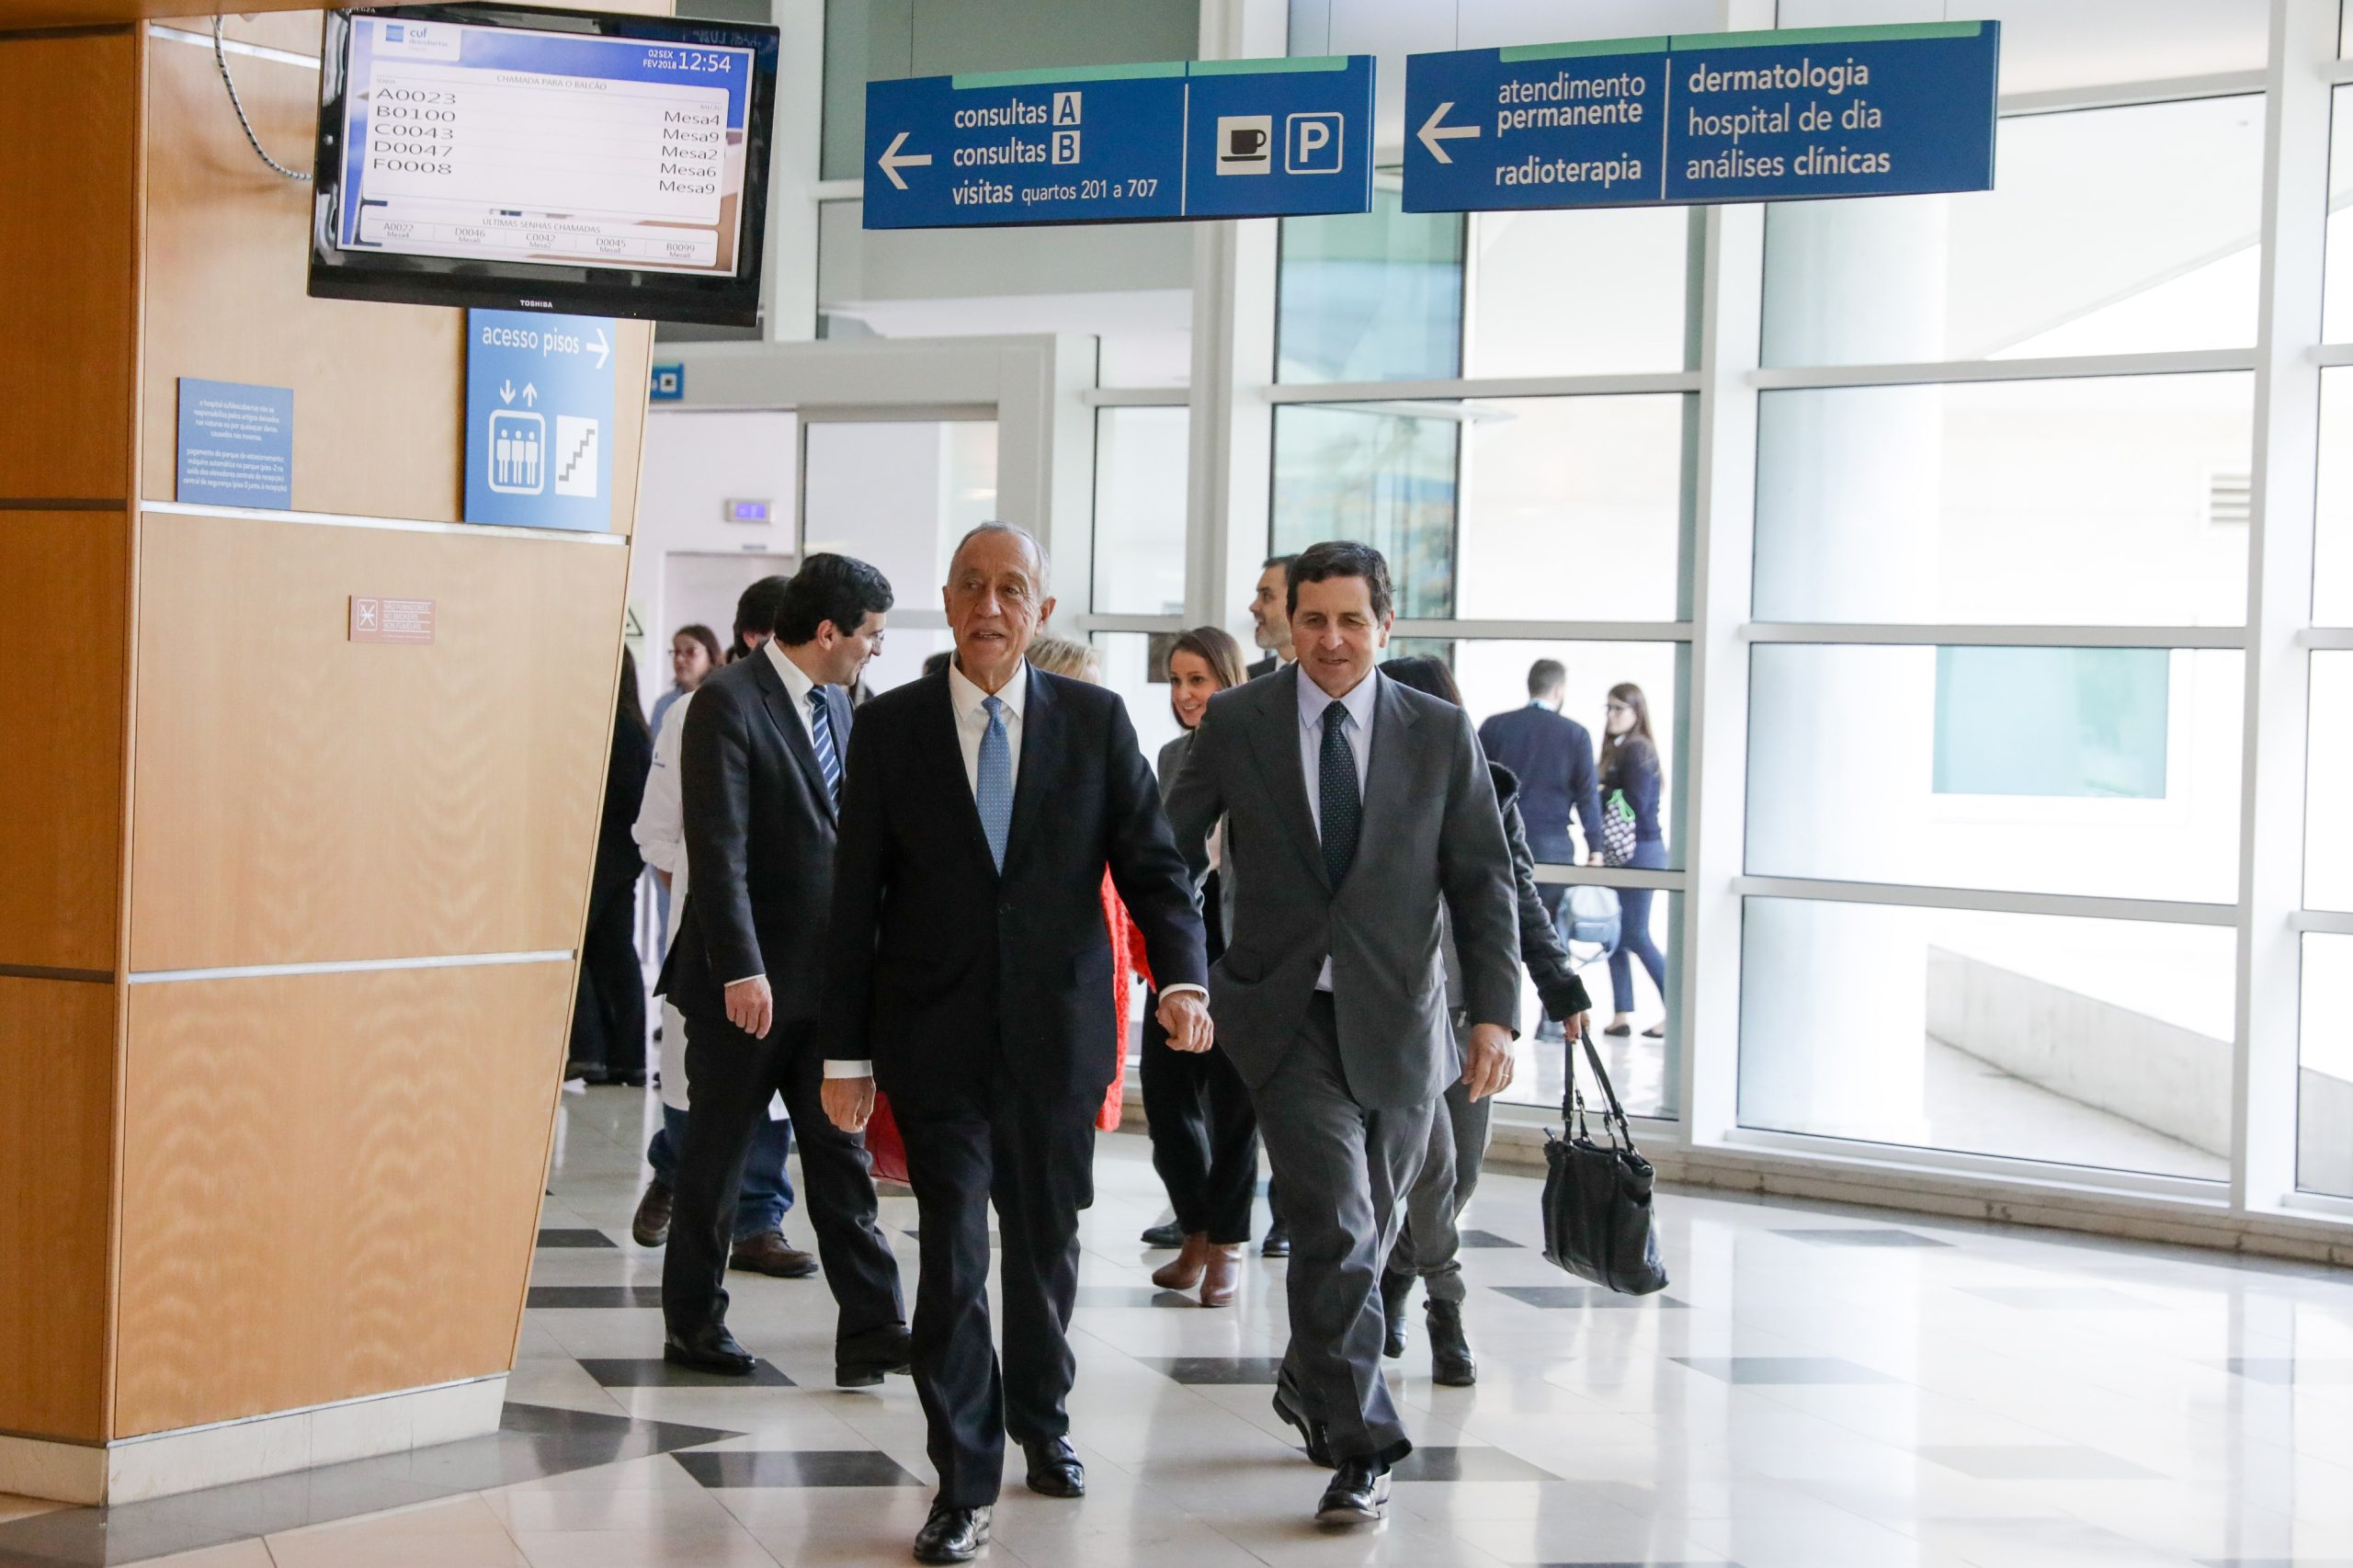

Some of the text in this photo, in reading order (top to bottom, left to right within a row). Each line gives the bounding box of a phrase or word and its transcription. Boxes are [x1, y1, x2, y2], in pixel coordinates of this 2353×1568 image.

[410, 28, 427, 38] cuf
[678, 51, 732, 73] 12:54
[496, 74, 540, 85] CHAMADA
[541, 77, 563, 87] PARA
[565, 80, 573, 88] O
[1688, 58, 1870, 94] dermatologia
[376, 88, 456, 105] A0023
[1498, 71, 1646, 105] atendimento
[376, 106, 456, 122] B0100
[664, 110, 721, 126] Mesa4
[954, 97, 1048, 129] consultas
[1496, 100, 1643, 137] permanente
[1688, 98, 1883, 143] hospital de dia
[375, 123, 453, 140] C0043
[663, 128, 719, 143] Mesa9
[374, 141, 453, 157] D0047
[662, 145, 718, 161] Mesa2
[953, 136, 1046, 167] consultas
[373, 158, 451, 175] F0008
[660, 163, 716, 177] Mesa6
[1495, 153, 1643, 189] radioterapia
[1686, 145, 1892, 180] análises clínicas
[659, 180, 715, 195] Mesa9
[952, 178, 1158, 207] visitas quartos 201 a 707
[520, 221, 551, 231] SENHAS
[553, 223, 601, 234] CHAMADAS
[520, 300, 552, 309] TOSHIBA
[483, 326, 579, 357] acesso pisos
